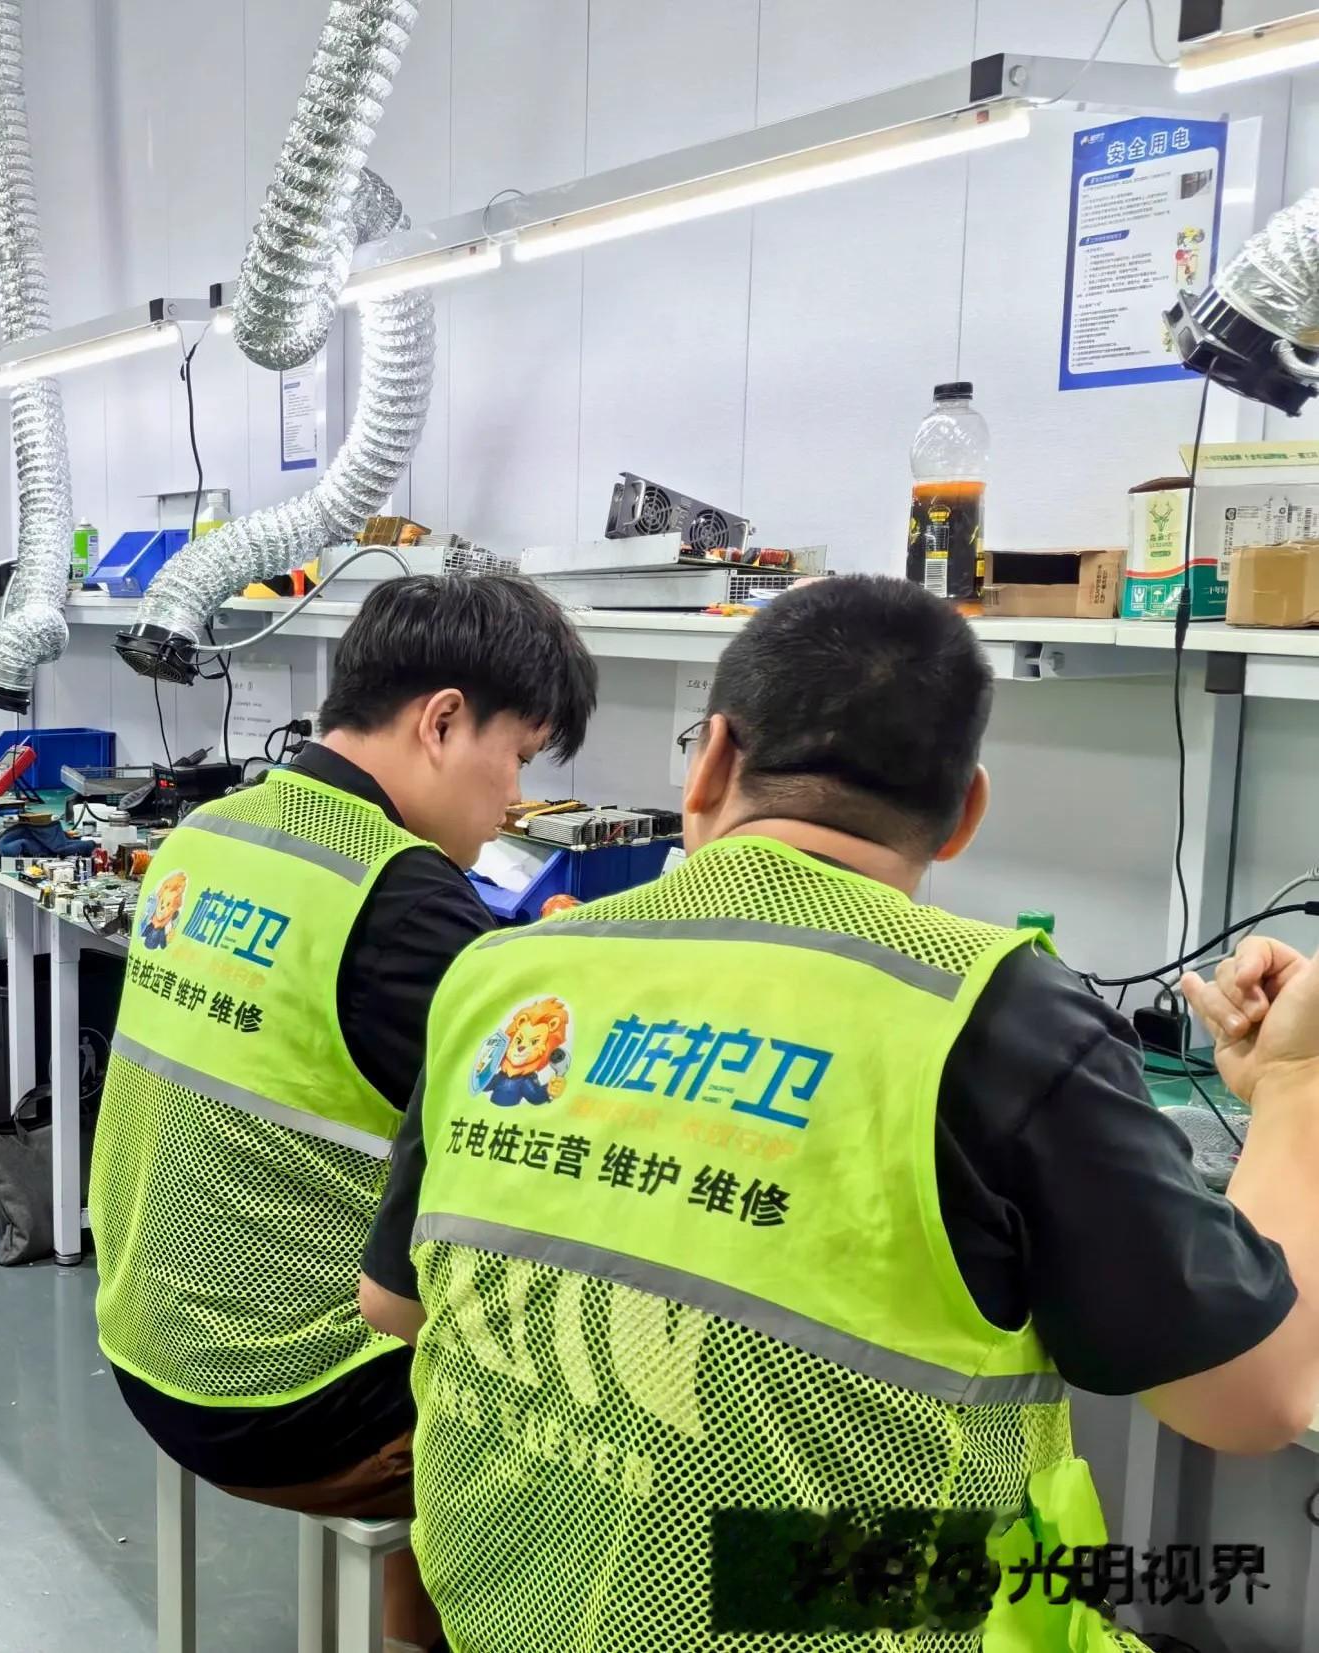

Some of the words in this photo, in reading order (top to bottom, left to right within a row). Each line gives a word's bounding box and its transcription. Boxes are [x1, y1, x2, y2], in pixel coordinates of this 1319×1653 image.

[1106, 127, 1191, 165] 安全用电
[181, 887, 292, 969] 桩护卫
[174, 977, 209, 1012] 维护
[207, 991, 264, 1033] 维修
[583, 1012, 835, 1130] 桩护卫
[445, 1116, 592, 1180] 充电桩运营
[597, 1142, 683, 1196] 维护
[686, 1163, 792, 1228] 维修
